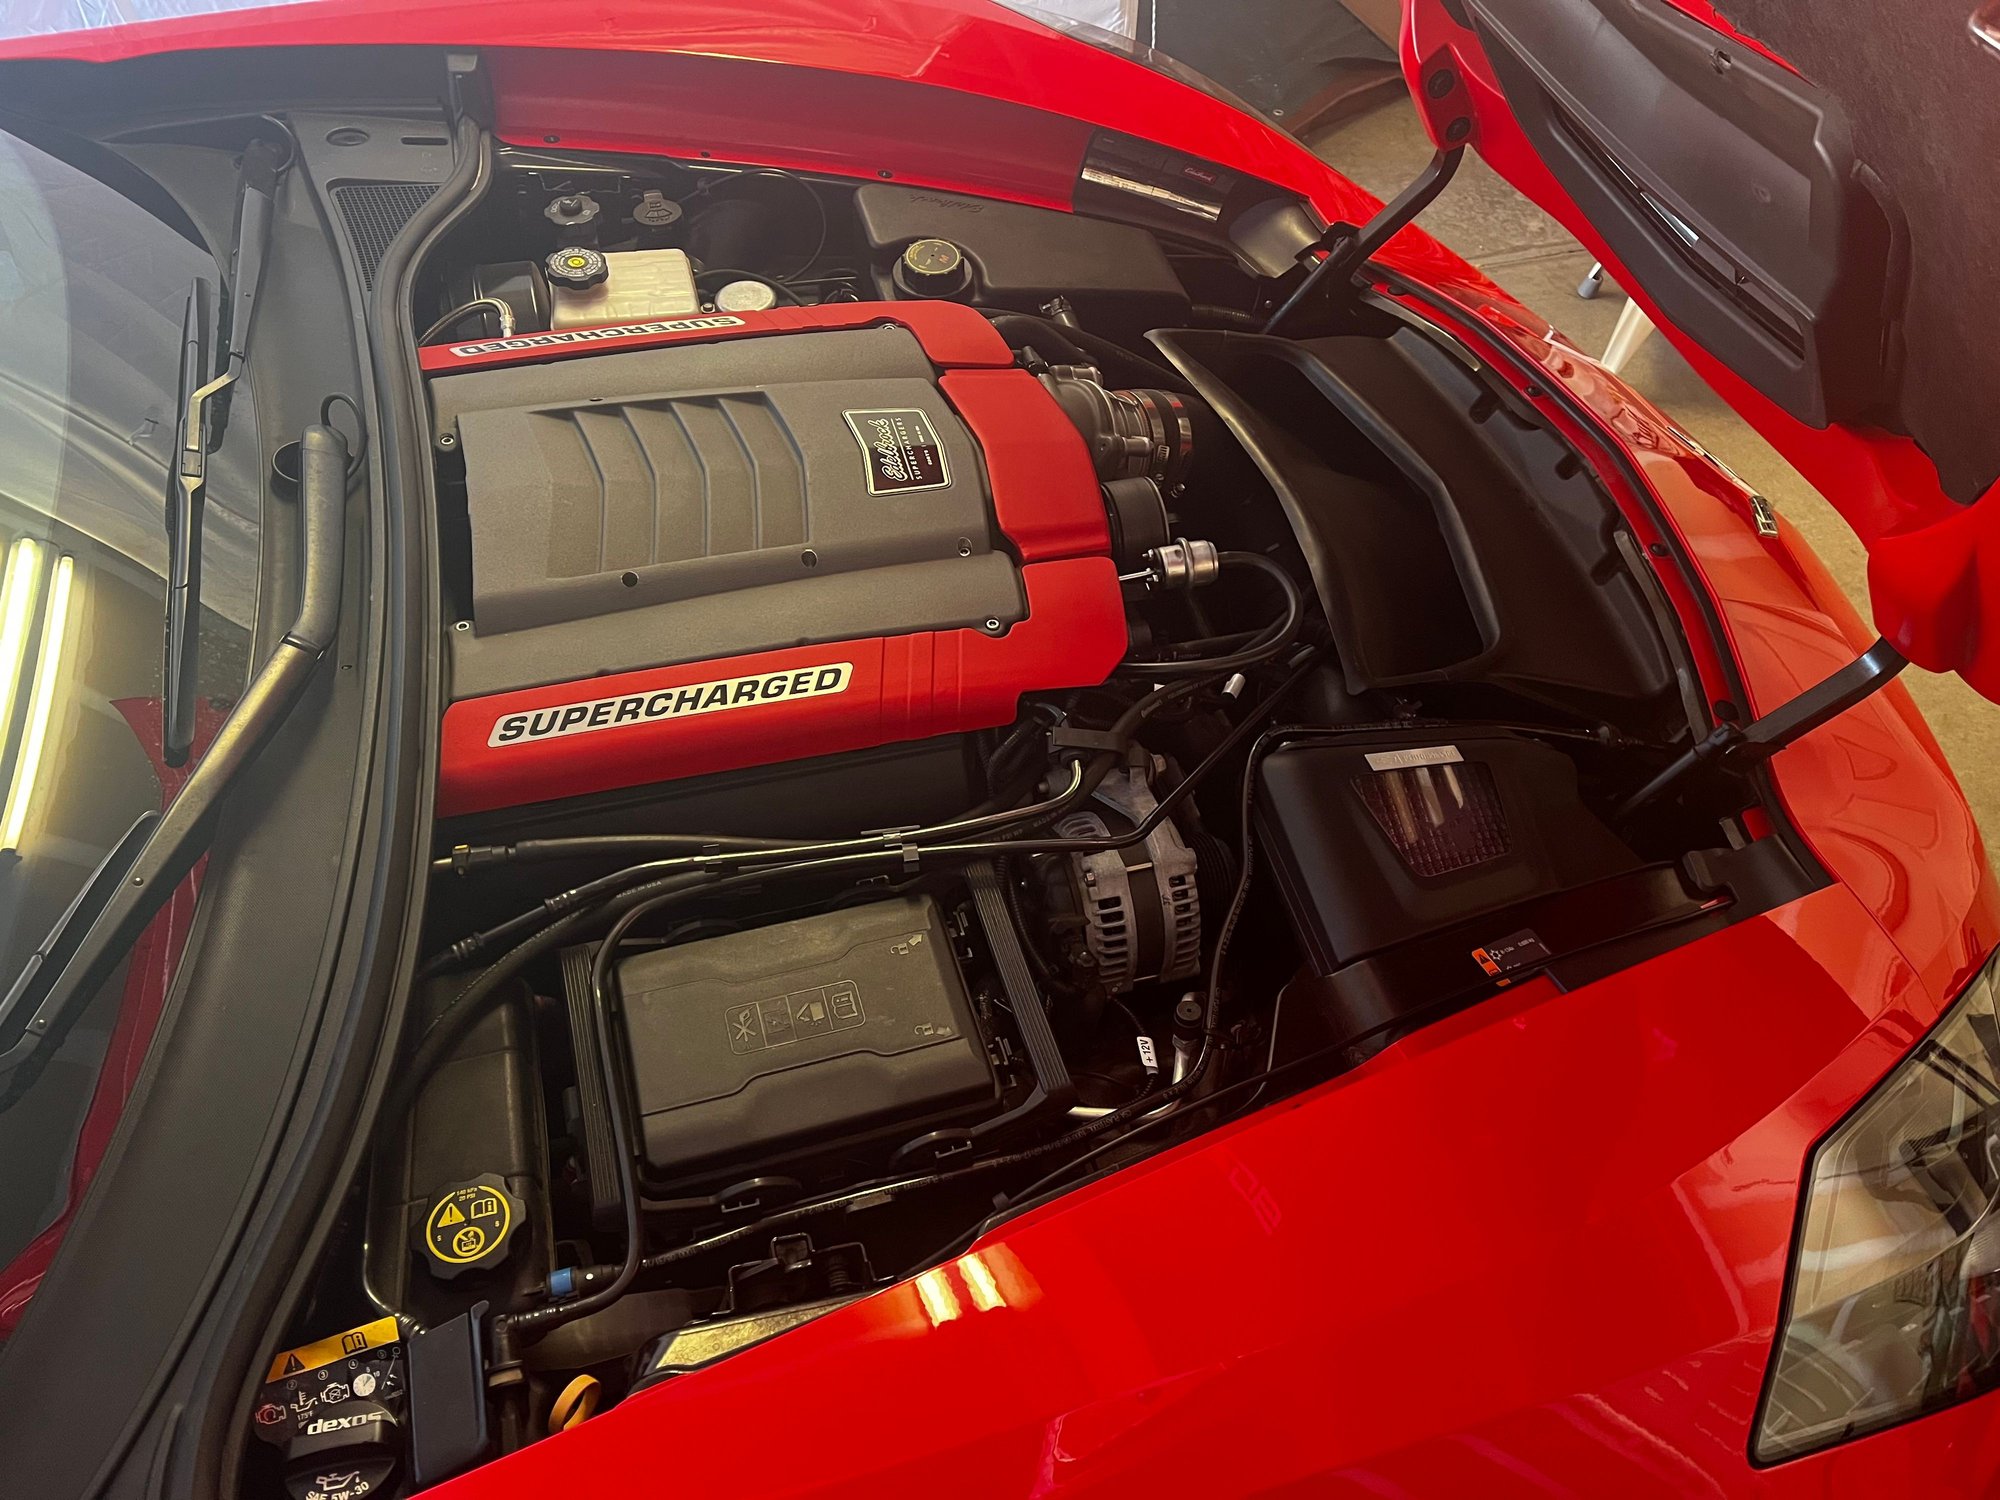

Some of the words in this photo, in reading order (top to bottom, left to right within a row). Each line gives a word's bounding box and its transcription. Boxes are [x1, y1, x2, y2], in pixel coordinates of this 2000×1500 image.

[459, 316, 738, 354] SUPERCHARGED
[868, 419, 908, 481] Edelbrock
[895, 418, 922, 480] SUPERCHARGERS
[498, 667, 842, 742] SUPERCHARGED
[1140, 1039, 1152, 1053] 12V
[307, 1411, 385, 1435] dexos
